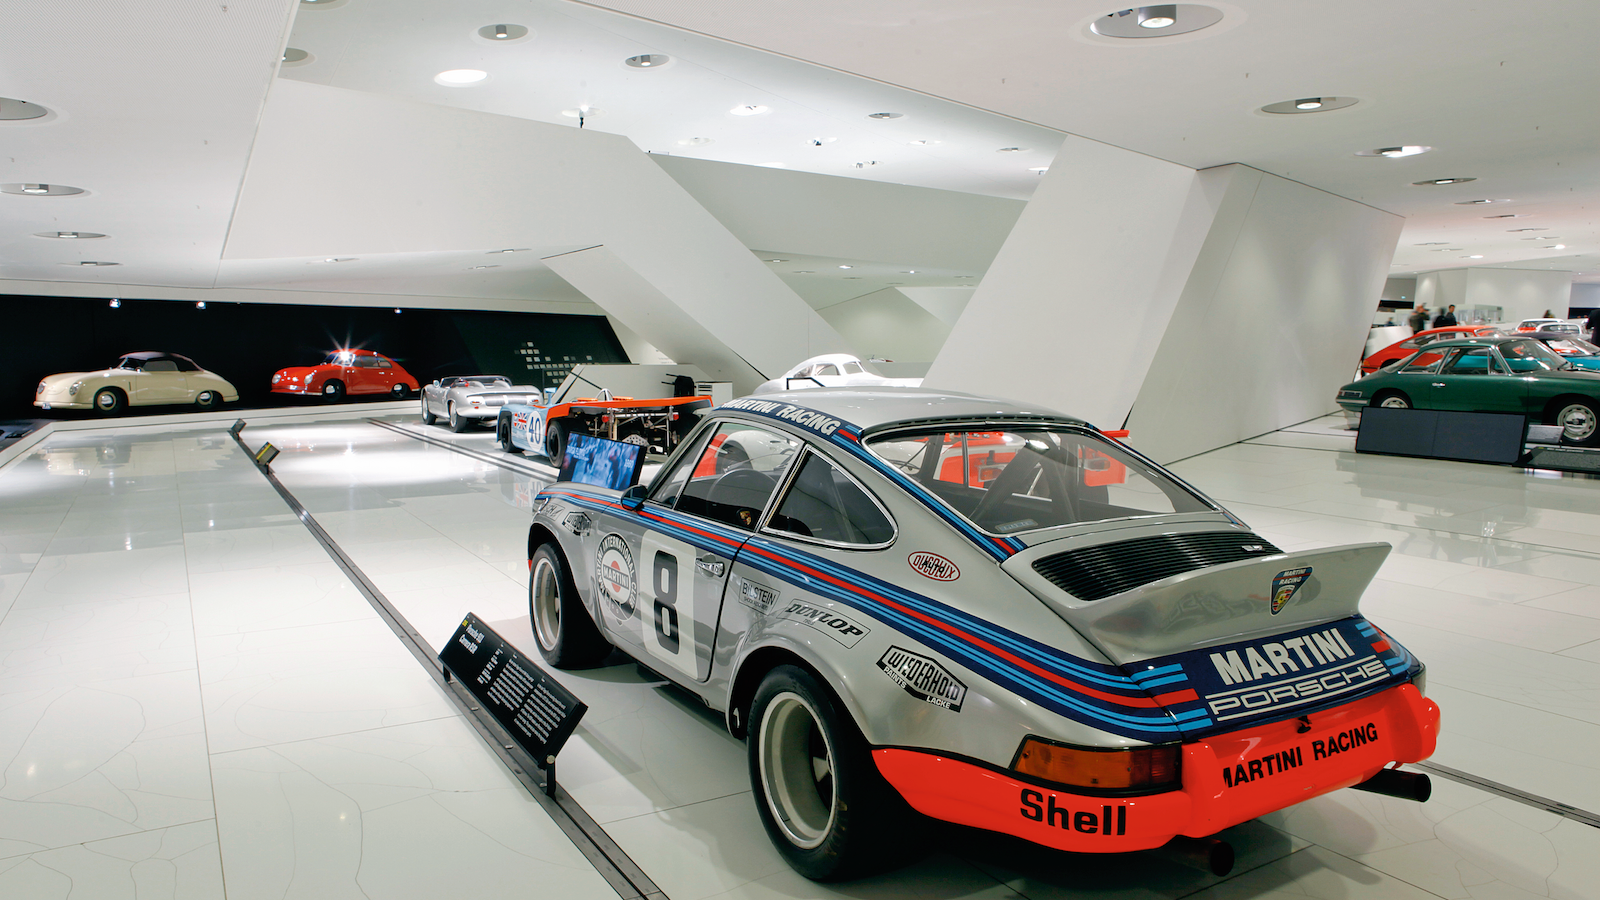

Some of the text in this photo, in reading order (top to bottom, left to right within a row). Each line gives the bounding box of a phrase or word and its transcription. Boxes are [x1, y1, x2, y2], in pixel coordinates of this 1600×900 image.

[528, 416, 541, 445] 40
[721, 399, 841, 436] MARTINI RACING
[602, 536, 635, 578] INTERNATIONAL
[922, 560, 945, 573] AUTO
[1283, 569, 1307, 577] MARTINI
[603, 565, 629, 589] MARTINI
[1279, 576, 1302, 586] RACING
[653, 550, 679, 655] 8
[742, 582, 777, 606] BILSTEIN
[785, 603, 864, 636] DUNLOP
[1209, 628, 1355, 685] MARTINI
[883, 666, 907, 689] PAINTS
[888, 652, 961, 701] WIEDERHOLD
[1208, 660, 1387, 715] PORSCHE
[926, 695, 951, 709] LACKE
[1312, 723, 1379, 761] RACING
[1020, 788, 1126, 836] Shell
